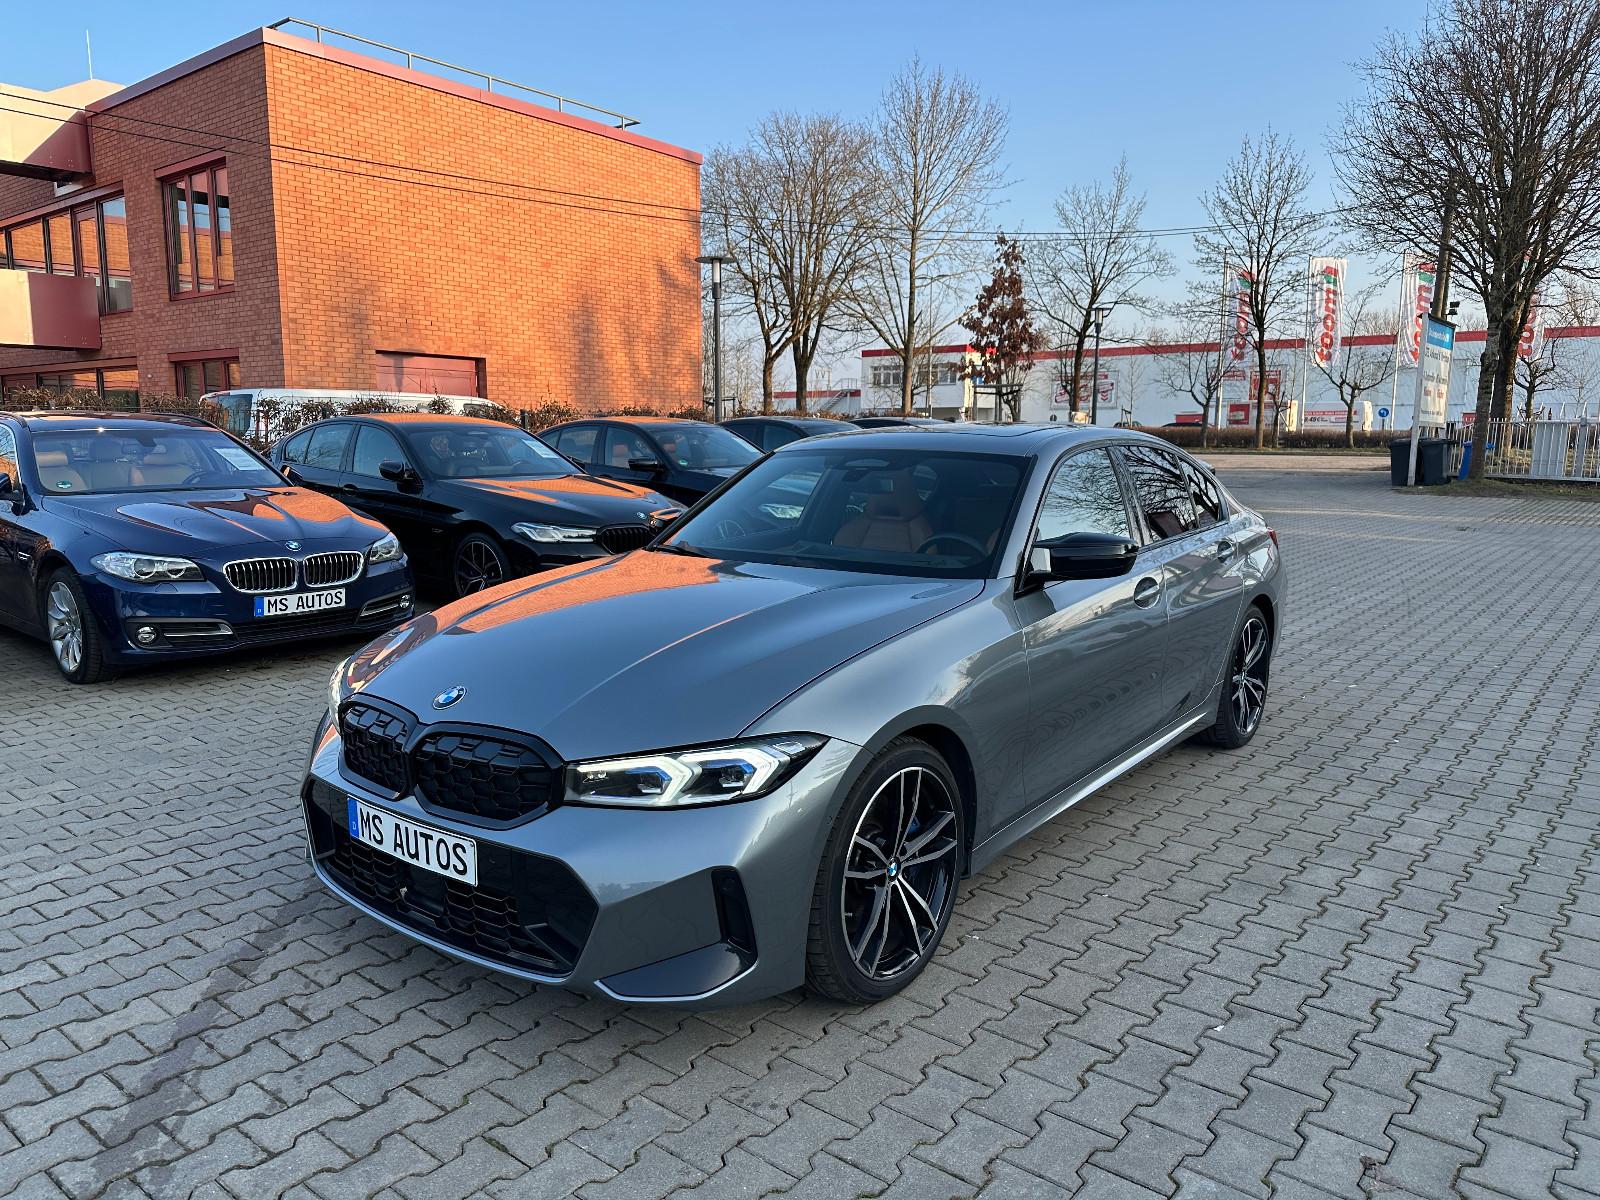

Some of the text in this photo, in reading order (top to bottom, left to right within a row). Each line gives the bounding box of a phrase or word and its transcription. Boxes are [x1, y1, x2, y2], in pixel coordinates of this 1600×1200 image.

[1315, 287, 1338, 361] toom
[267, 591, 342, 613] MS AUTOS
[352, 821, 357, 830] D
[359, 807, 468, 876] MS AUTOS
